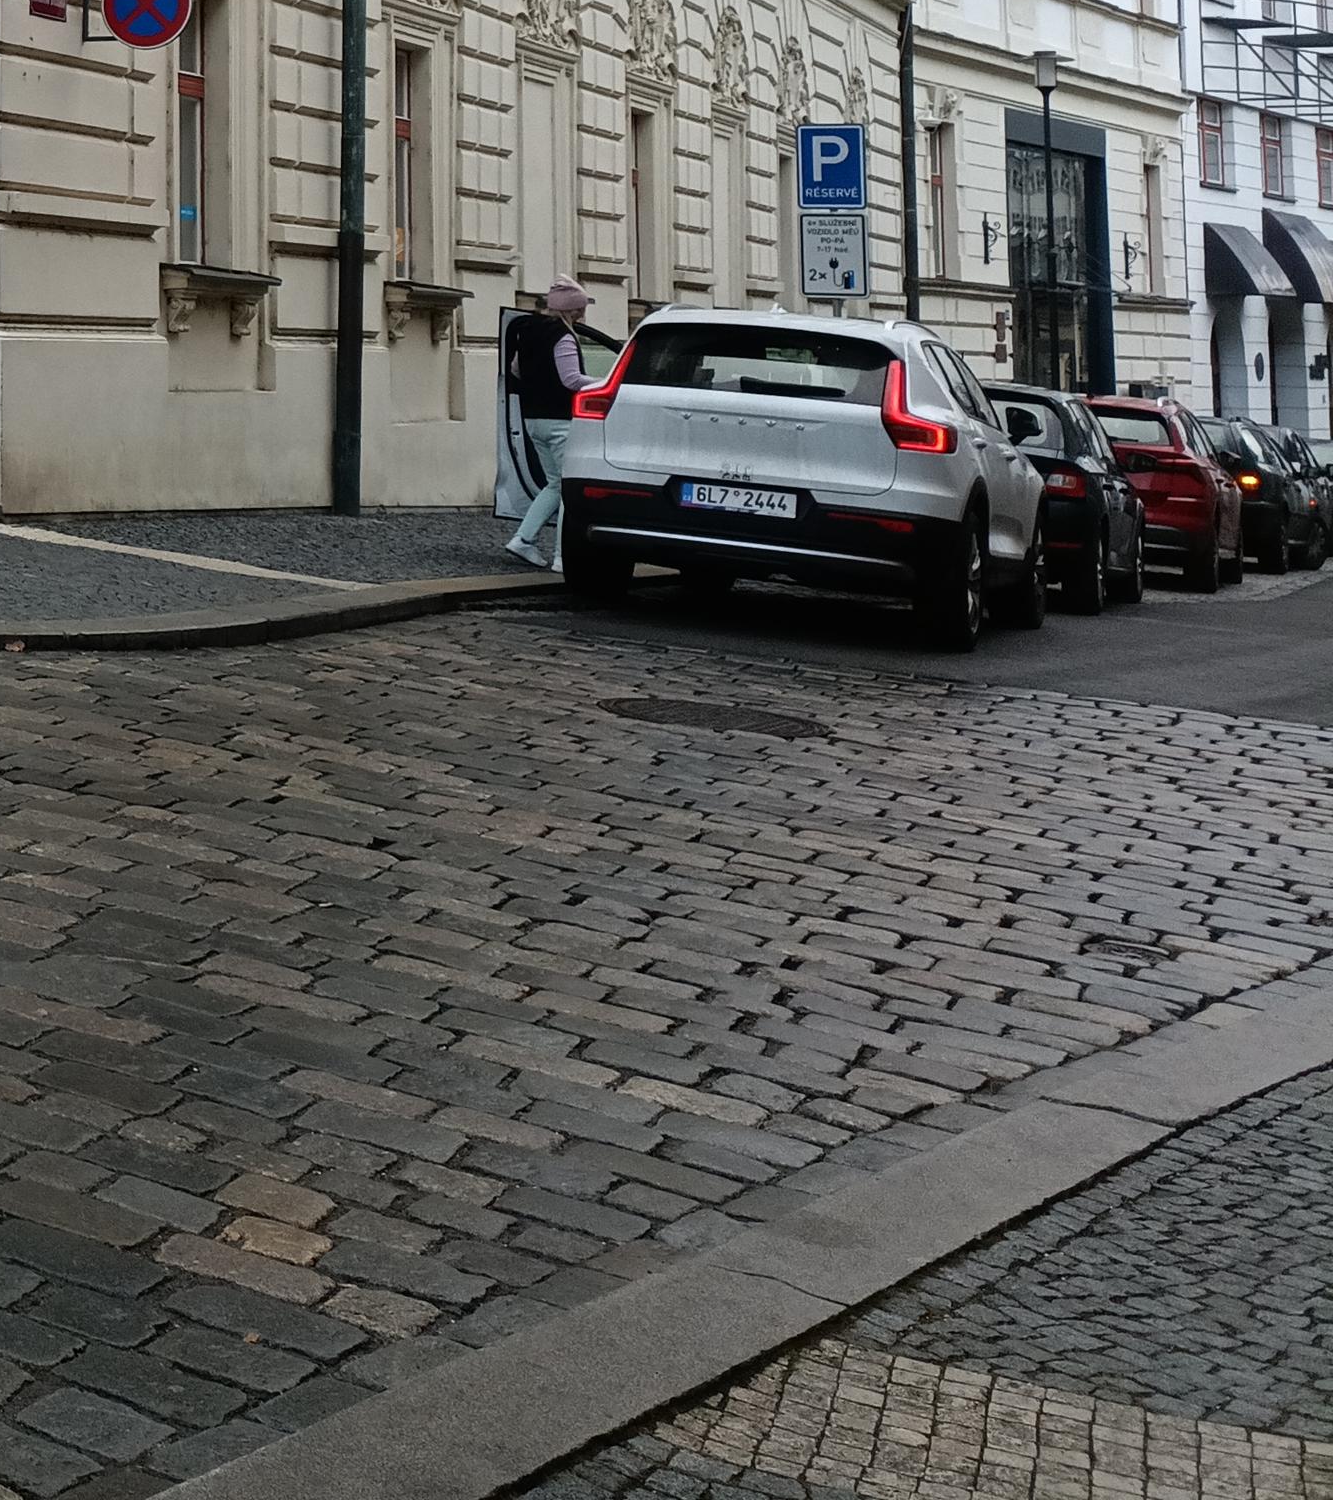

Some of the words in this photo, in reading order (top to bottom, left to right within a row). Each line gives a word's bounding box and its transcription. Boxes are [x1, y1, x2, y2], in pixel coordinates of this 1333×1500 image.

[811, 135, 849, 182] P
[805, 187, 860, 198] RÉSERVÉ
[806, 228, 840, 236] VOZIDLO
[681, 411, 806, 432] VOLVO
[696, 486, 730, 505] 6L7
[743, 490, 788, 512] 2444
